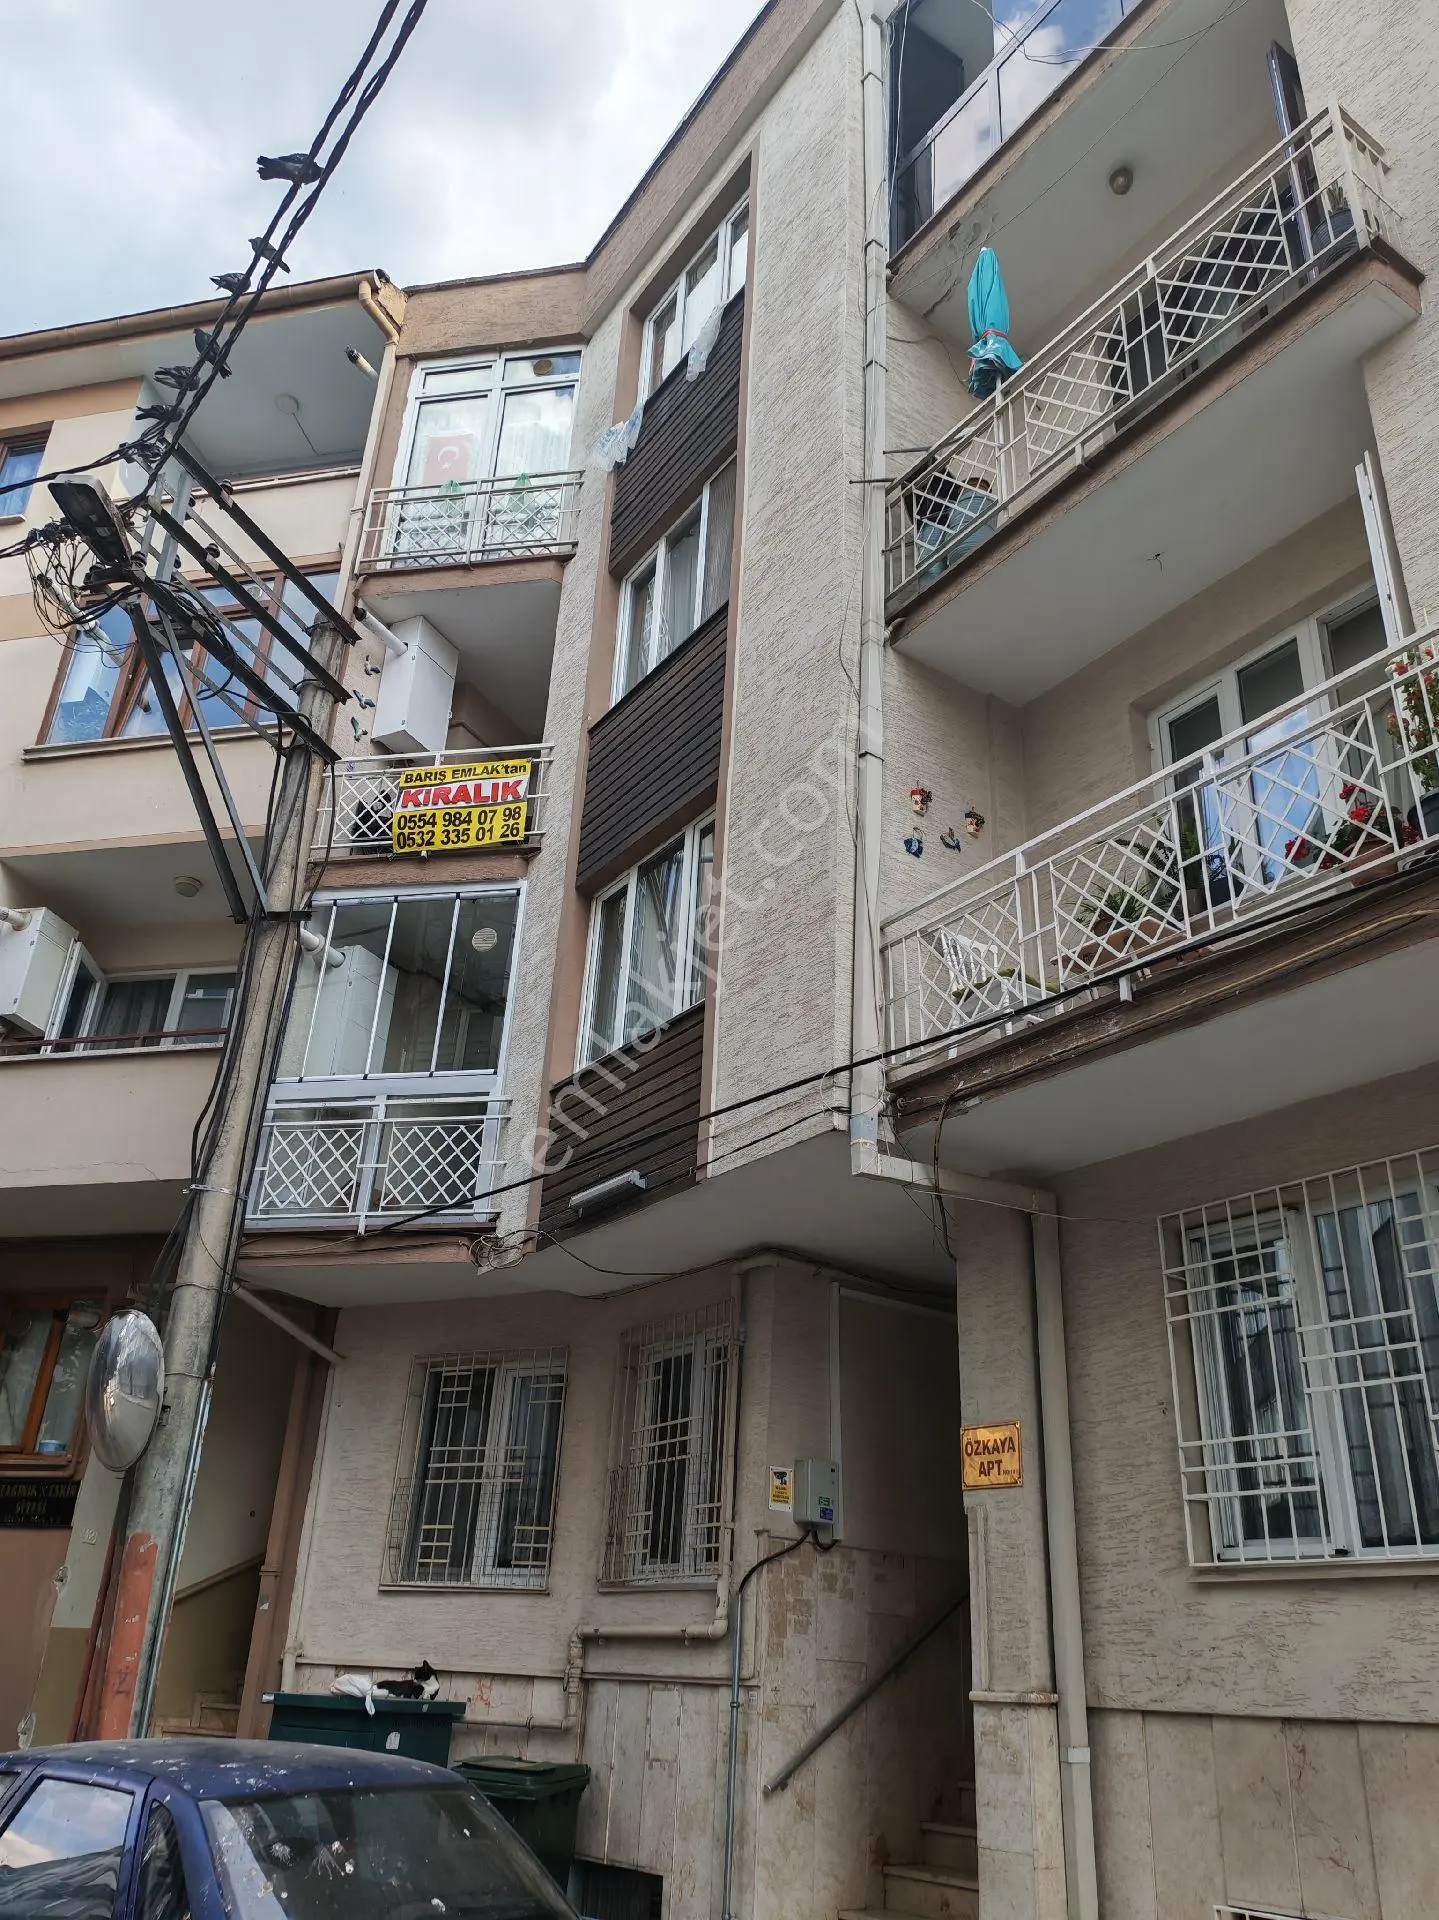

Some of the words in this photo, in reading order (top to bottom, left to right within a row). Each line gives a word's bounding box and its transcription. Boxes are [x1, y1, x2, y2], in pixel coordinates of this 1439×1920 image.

[404, 770, 447, 784] BARIŞ
[397, 812, 437, 831] 0554
[442, 810, 473, 827] 984
[477, 809, 497, 826] 07
[502, 805, 522, 822] 98
[396, 829, 436, 849] 0532
[441, 827, 471, 846] 335
[475, 825, 494, 842] 01
[500, 821, 520, 839] 26
[964, 1436, 1016, 1457] ÖZKAYA
